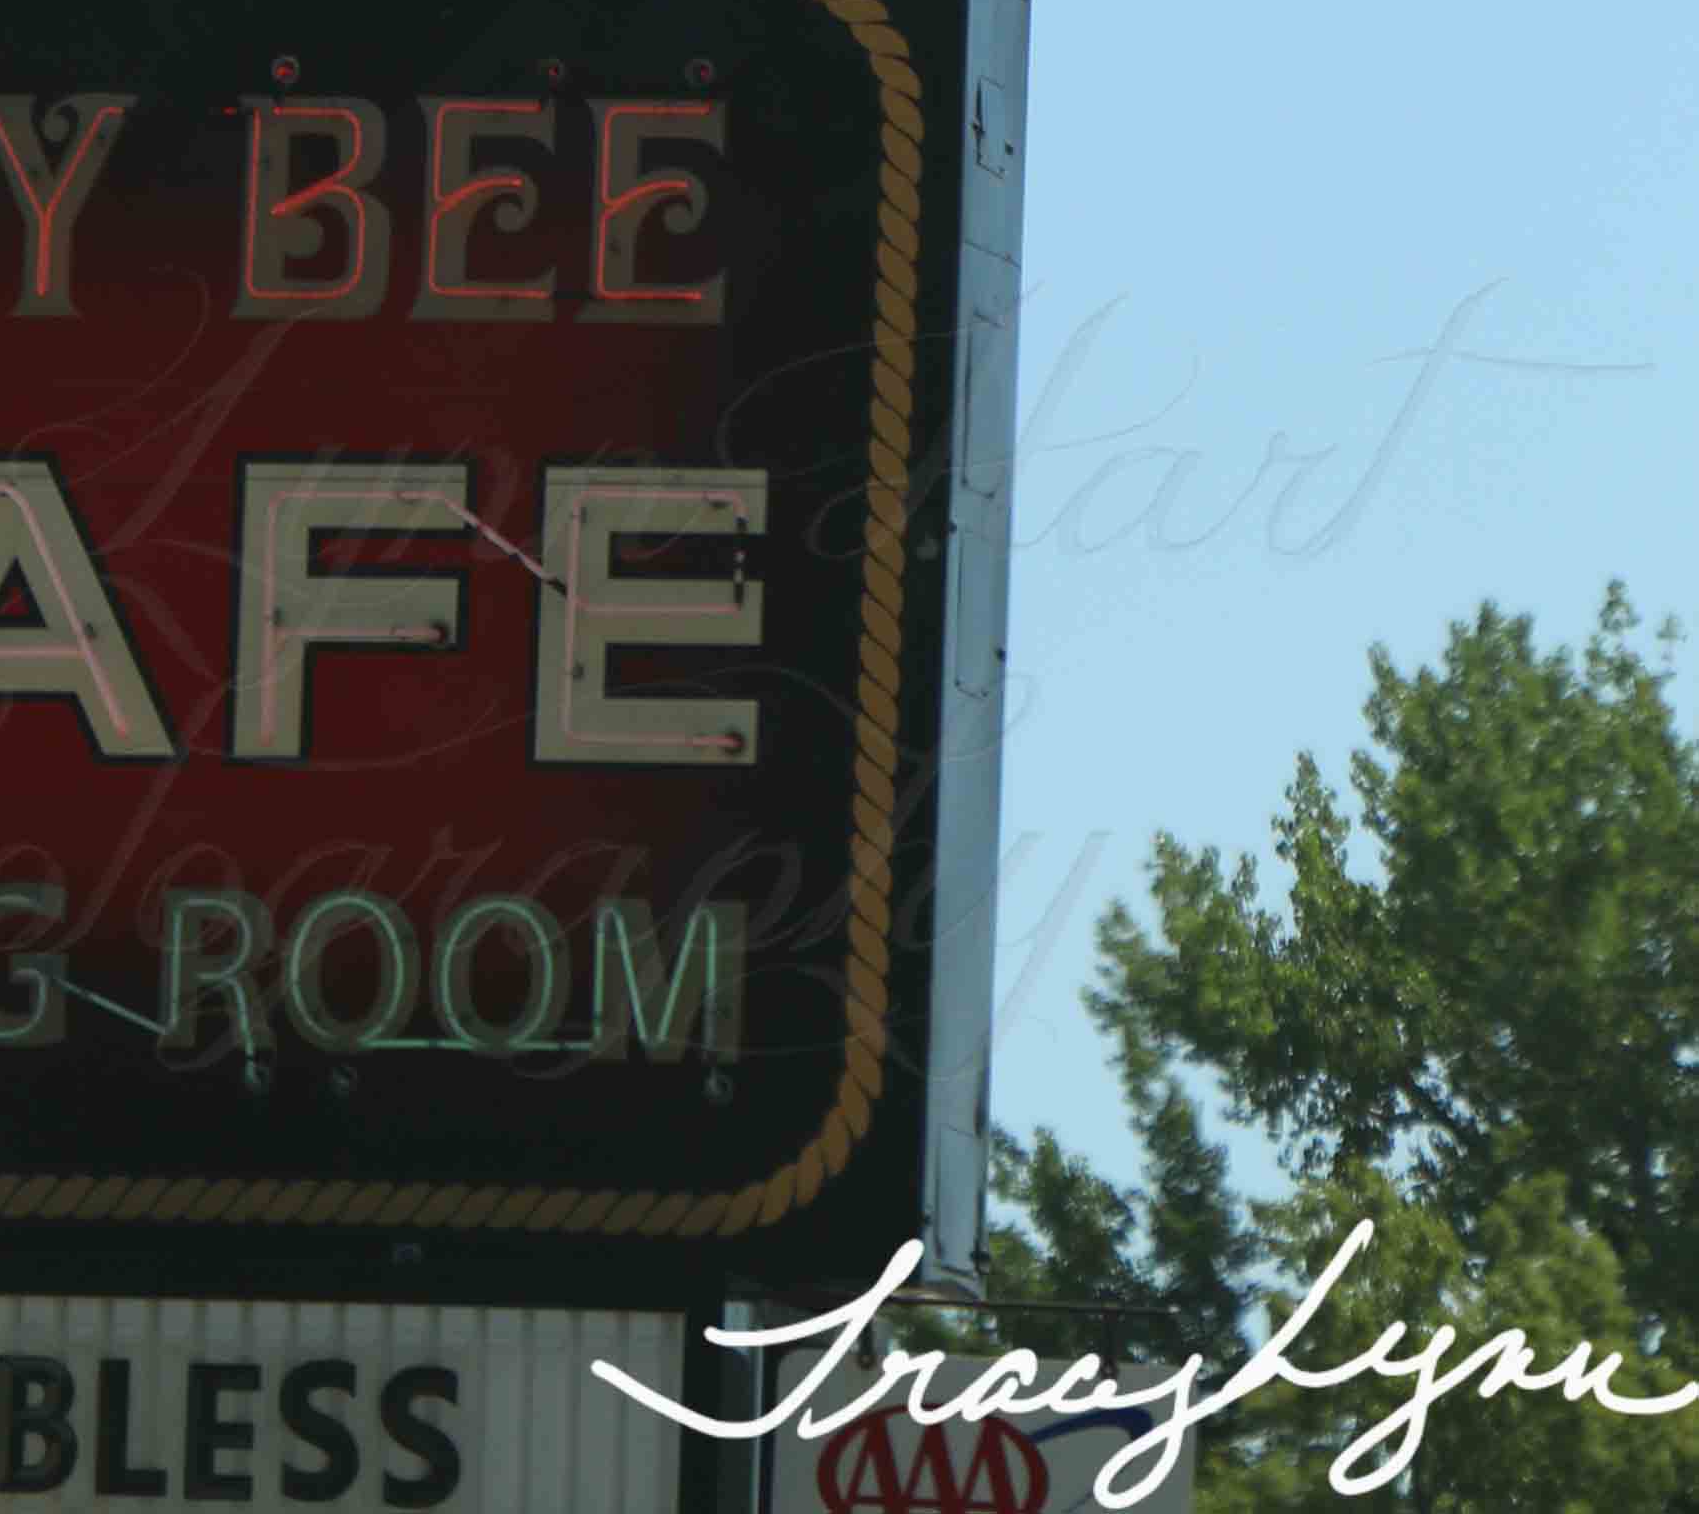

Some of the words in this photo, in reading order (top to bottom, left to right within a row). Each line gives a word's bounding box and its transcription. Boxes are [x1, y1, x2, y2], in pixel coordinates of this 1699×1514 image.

[231, 93, 729, 324] BEE
[159, 891, 746, 1066] ROOM
[833, 1407, 1033, 1514] AAA
